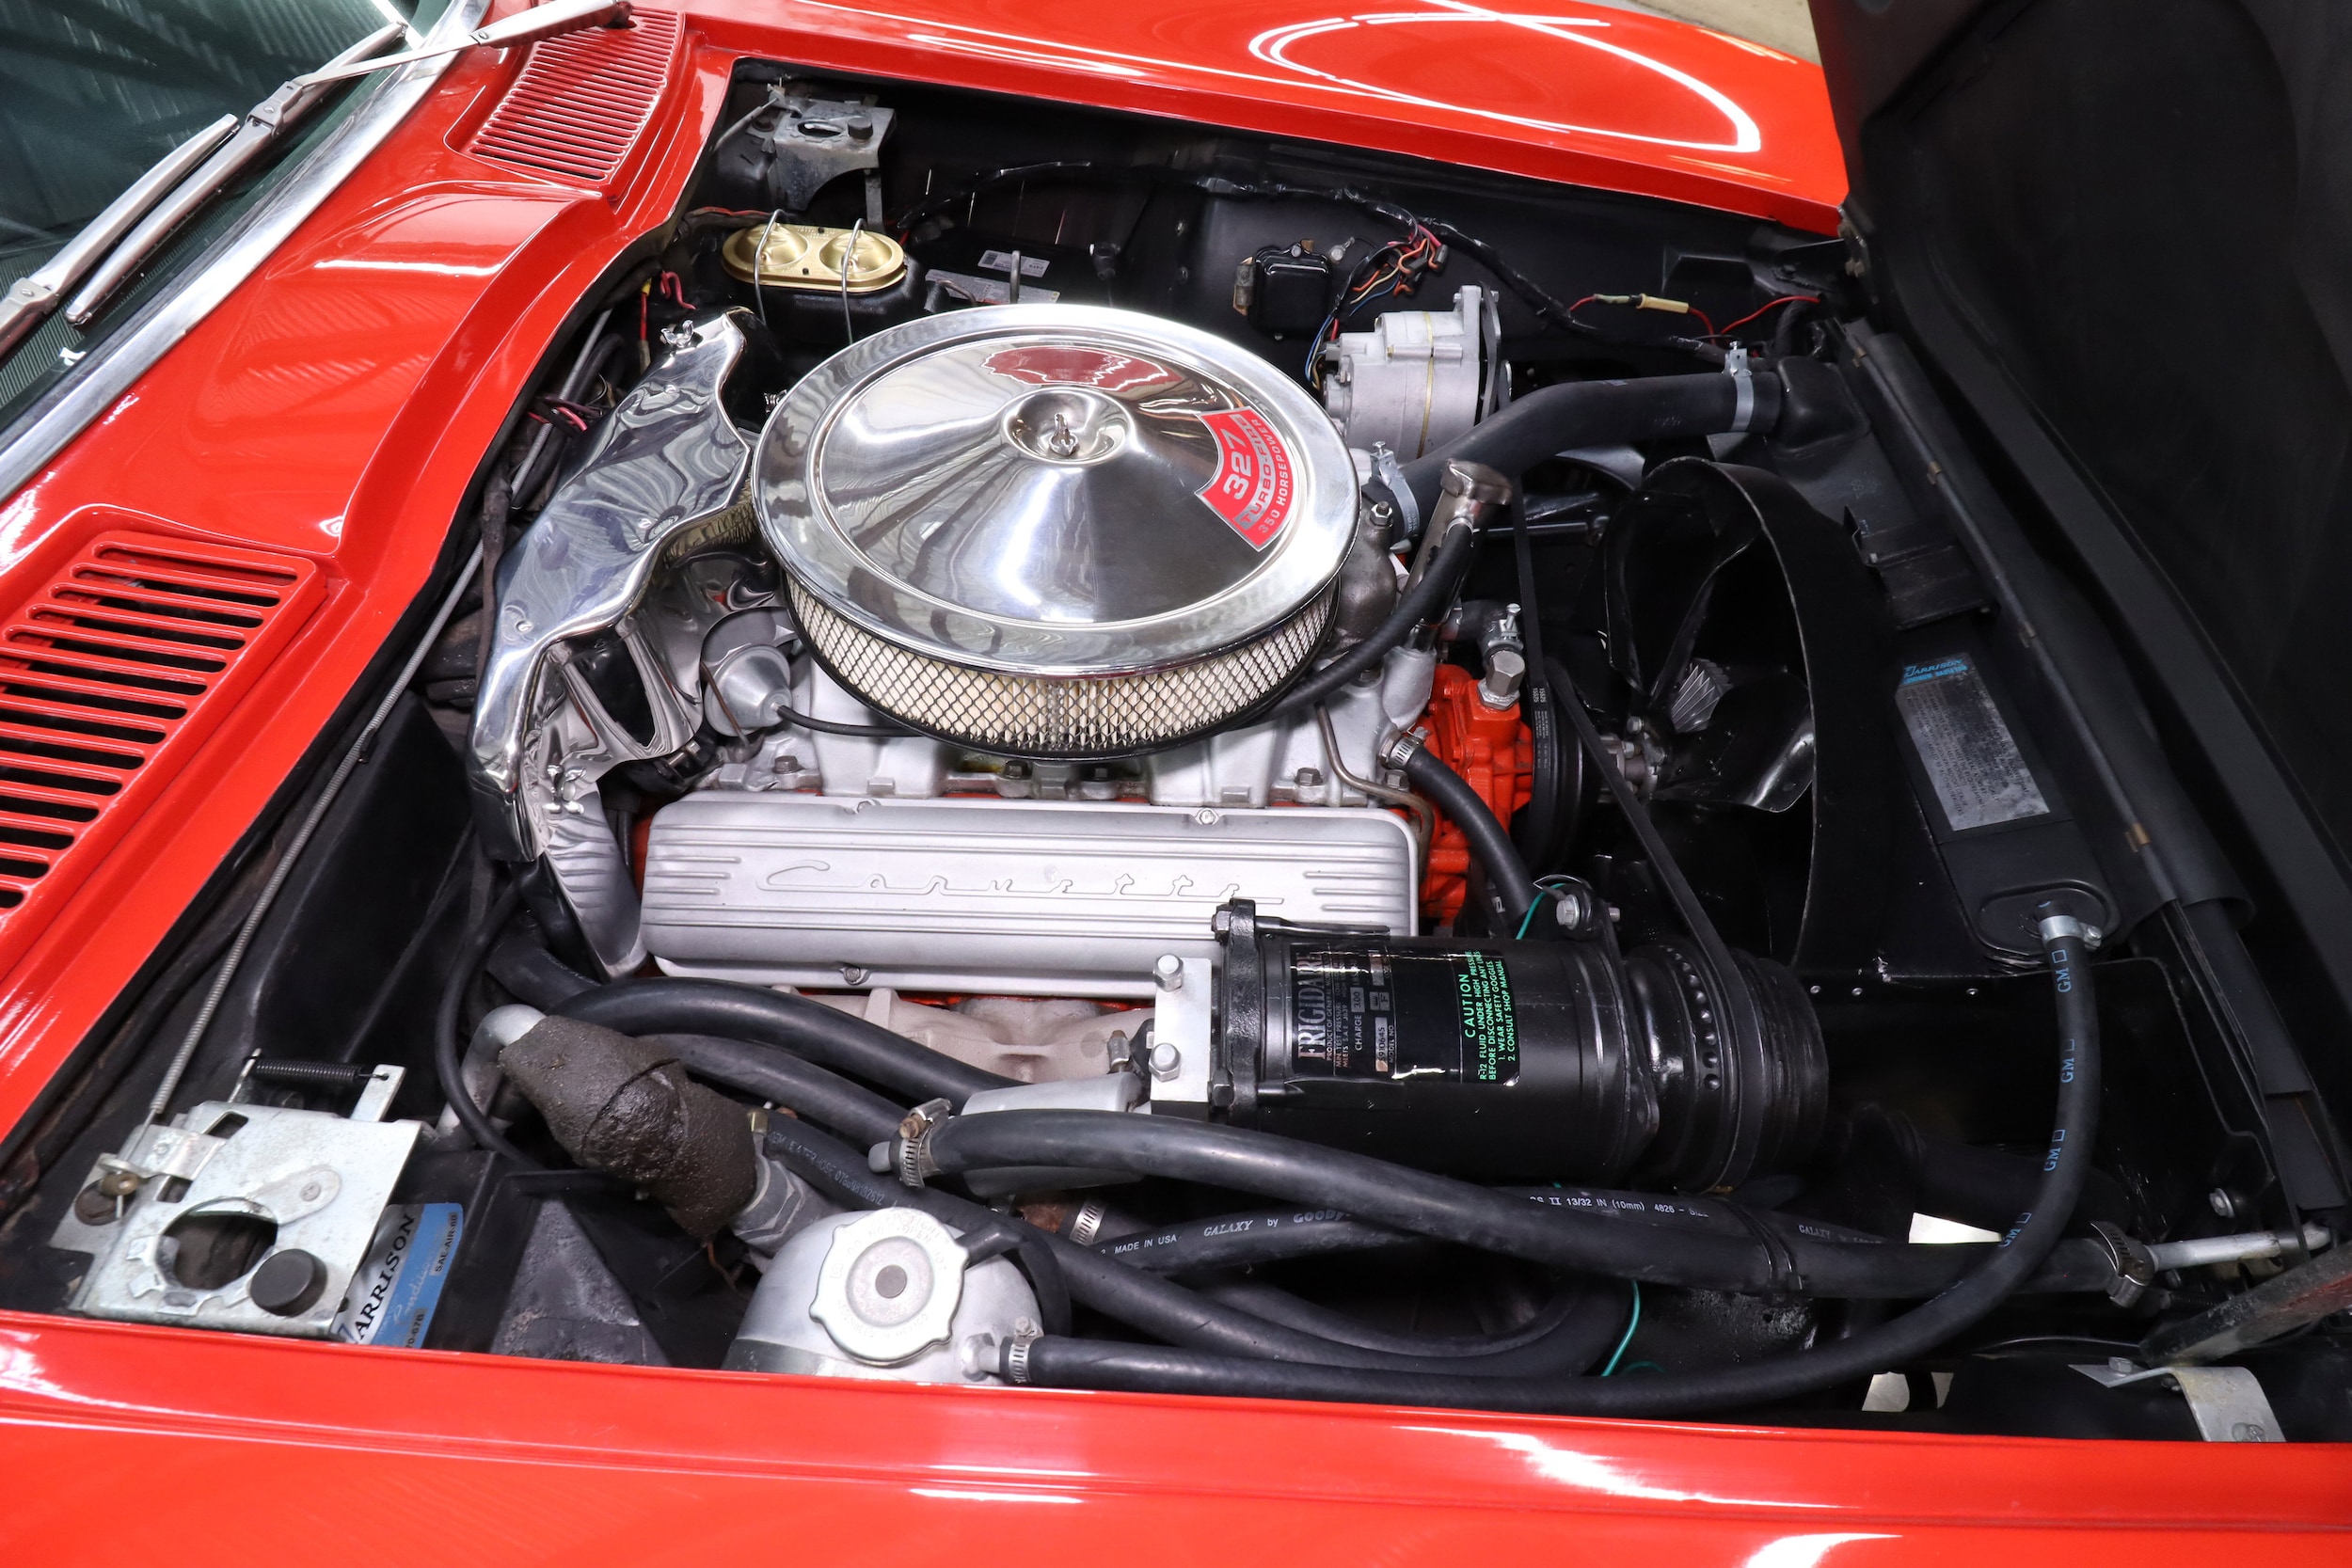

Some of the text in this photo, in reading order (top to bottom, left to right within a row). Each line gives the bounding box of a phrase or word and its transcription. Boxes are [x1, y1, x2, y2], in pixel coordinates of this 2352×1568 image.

[1219, 429, 1252, 499] 327
[1250, 419, 1289, 533] 350 HORSEPOWER
[1464, 950, 1478, 975] PRESSURE
[1478, 965, 1487, 978] ANY
[1471, 978, 1482, 997] HIGH
[2057, 967, 2072, 993] GM
[1296, 952, 1326, 1059] FRIGIDAIRE
[1458, 973, 1475, 1037] CAUTION
[1480, 980, 1495, 1044] DISCONNECTING
[1492, 994, 1503, 1022] SAFETY
[1501, 990, 1511, 1011] SHOP
[1327, 1018, 1332, 1027] OF
[1475, 1001, 1485, 1029] UNDER
[1353, 1014, 1362, 1050] CHARGE
[1496, 1025, 1505, 1051] WEAR
[1505, 1014, 1515, 1052] CONSULT
[1478, 1034, 1486, 1057] FLUID
[1487, 1047, 1496, 1080] BEFORE
[2060, 1058, 2075, 1084] GM
[2043, 1147, 2061, 1172] GM
[1565, 1196, 1592, 1209] 13/32
[1597, 1197, 1608, 1208] IN
[1612, 1198, 1645, 1212] (10mm)
[1203, 1219, 1254, 1237] GALAXY
[1266, 1217, 1279, 1227] by
[1999, 1225, 2023, 1248] GM
[1114, 1241, 1139, 1255] MADE
[1143, 1239, 1153, 1249] IN
[1157, 1233, 1178, 1246] USA
